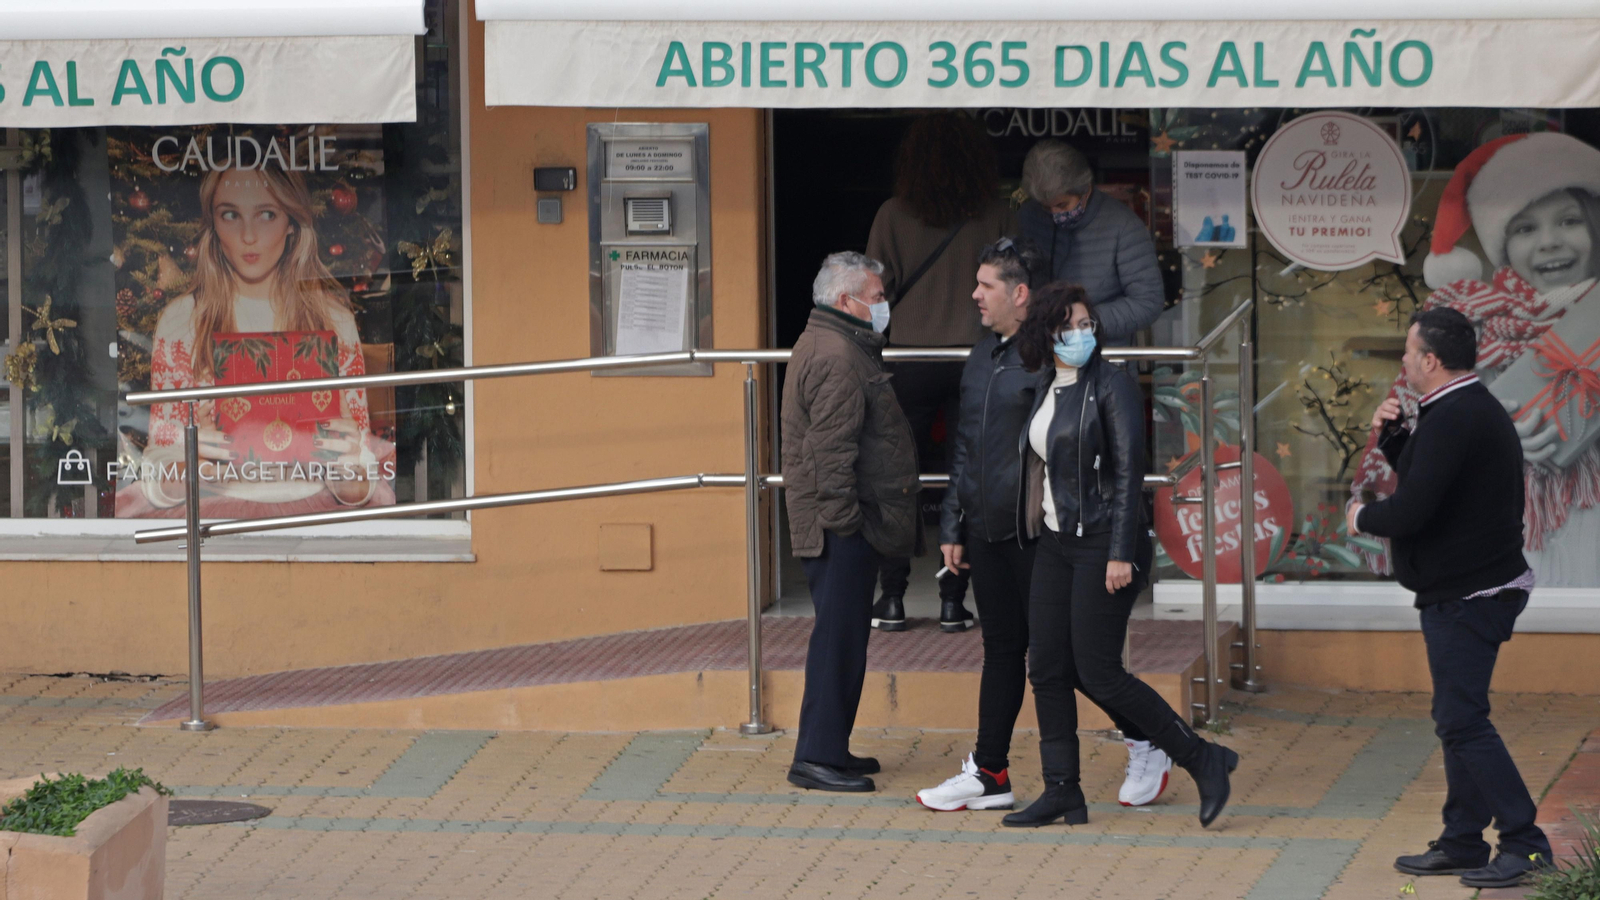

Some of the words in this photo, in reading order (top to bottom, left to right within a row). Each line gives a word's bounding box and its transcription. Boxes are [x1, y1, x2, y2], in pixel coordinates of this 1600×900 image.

[655, 40, 909, 89] ABIERTO
[926, 40, 1031, 89] 365
[1053, 40, 1190, 89] DIAS
[1206, 40, 1279, 88] AL
[1295, 27, 1434, 89] AÑO
[22, 60, 95, 107] AL
[111, 46, 245, 106] AÑO
[151, 125, 340, 172] CAUDALÍE
[1330, 150, 1354, 158] GIRA
[1359, 150, 1371, 158] LA
[1184, 161, 1229, 169] Disponemos
[1280, 149, 1377, 191] Ruleta
[1281, 190, 1377, 207] NAVIDEÑA
[1330, 214, 1336, 223] Y
[1340, 214, 1372, 223] GANA
[1289, 227, 1305, 237] TU
[1311, 227, 1371, 237] PREMIO!
[625, 250, 689, 261] FARMACIA
